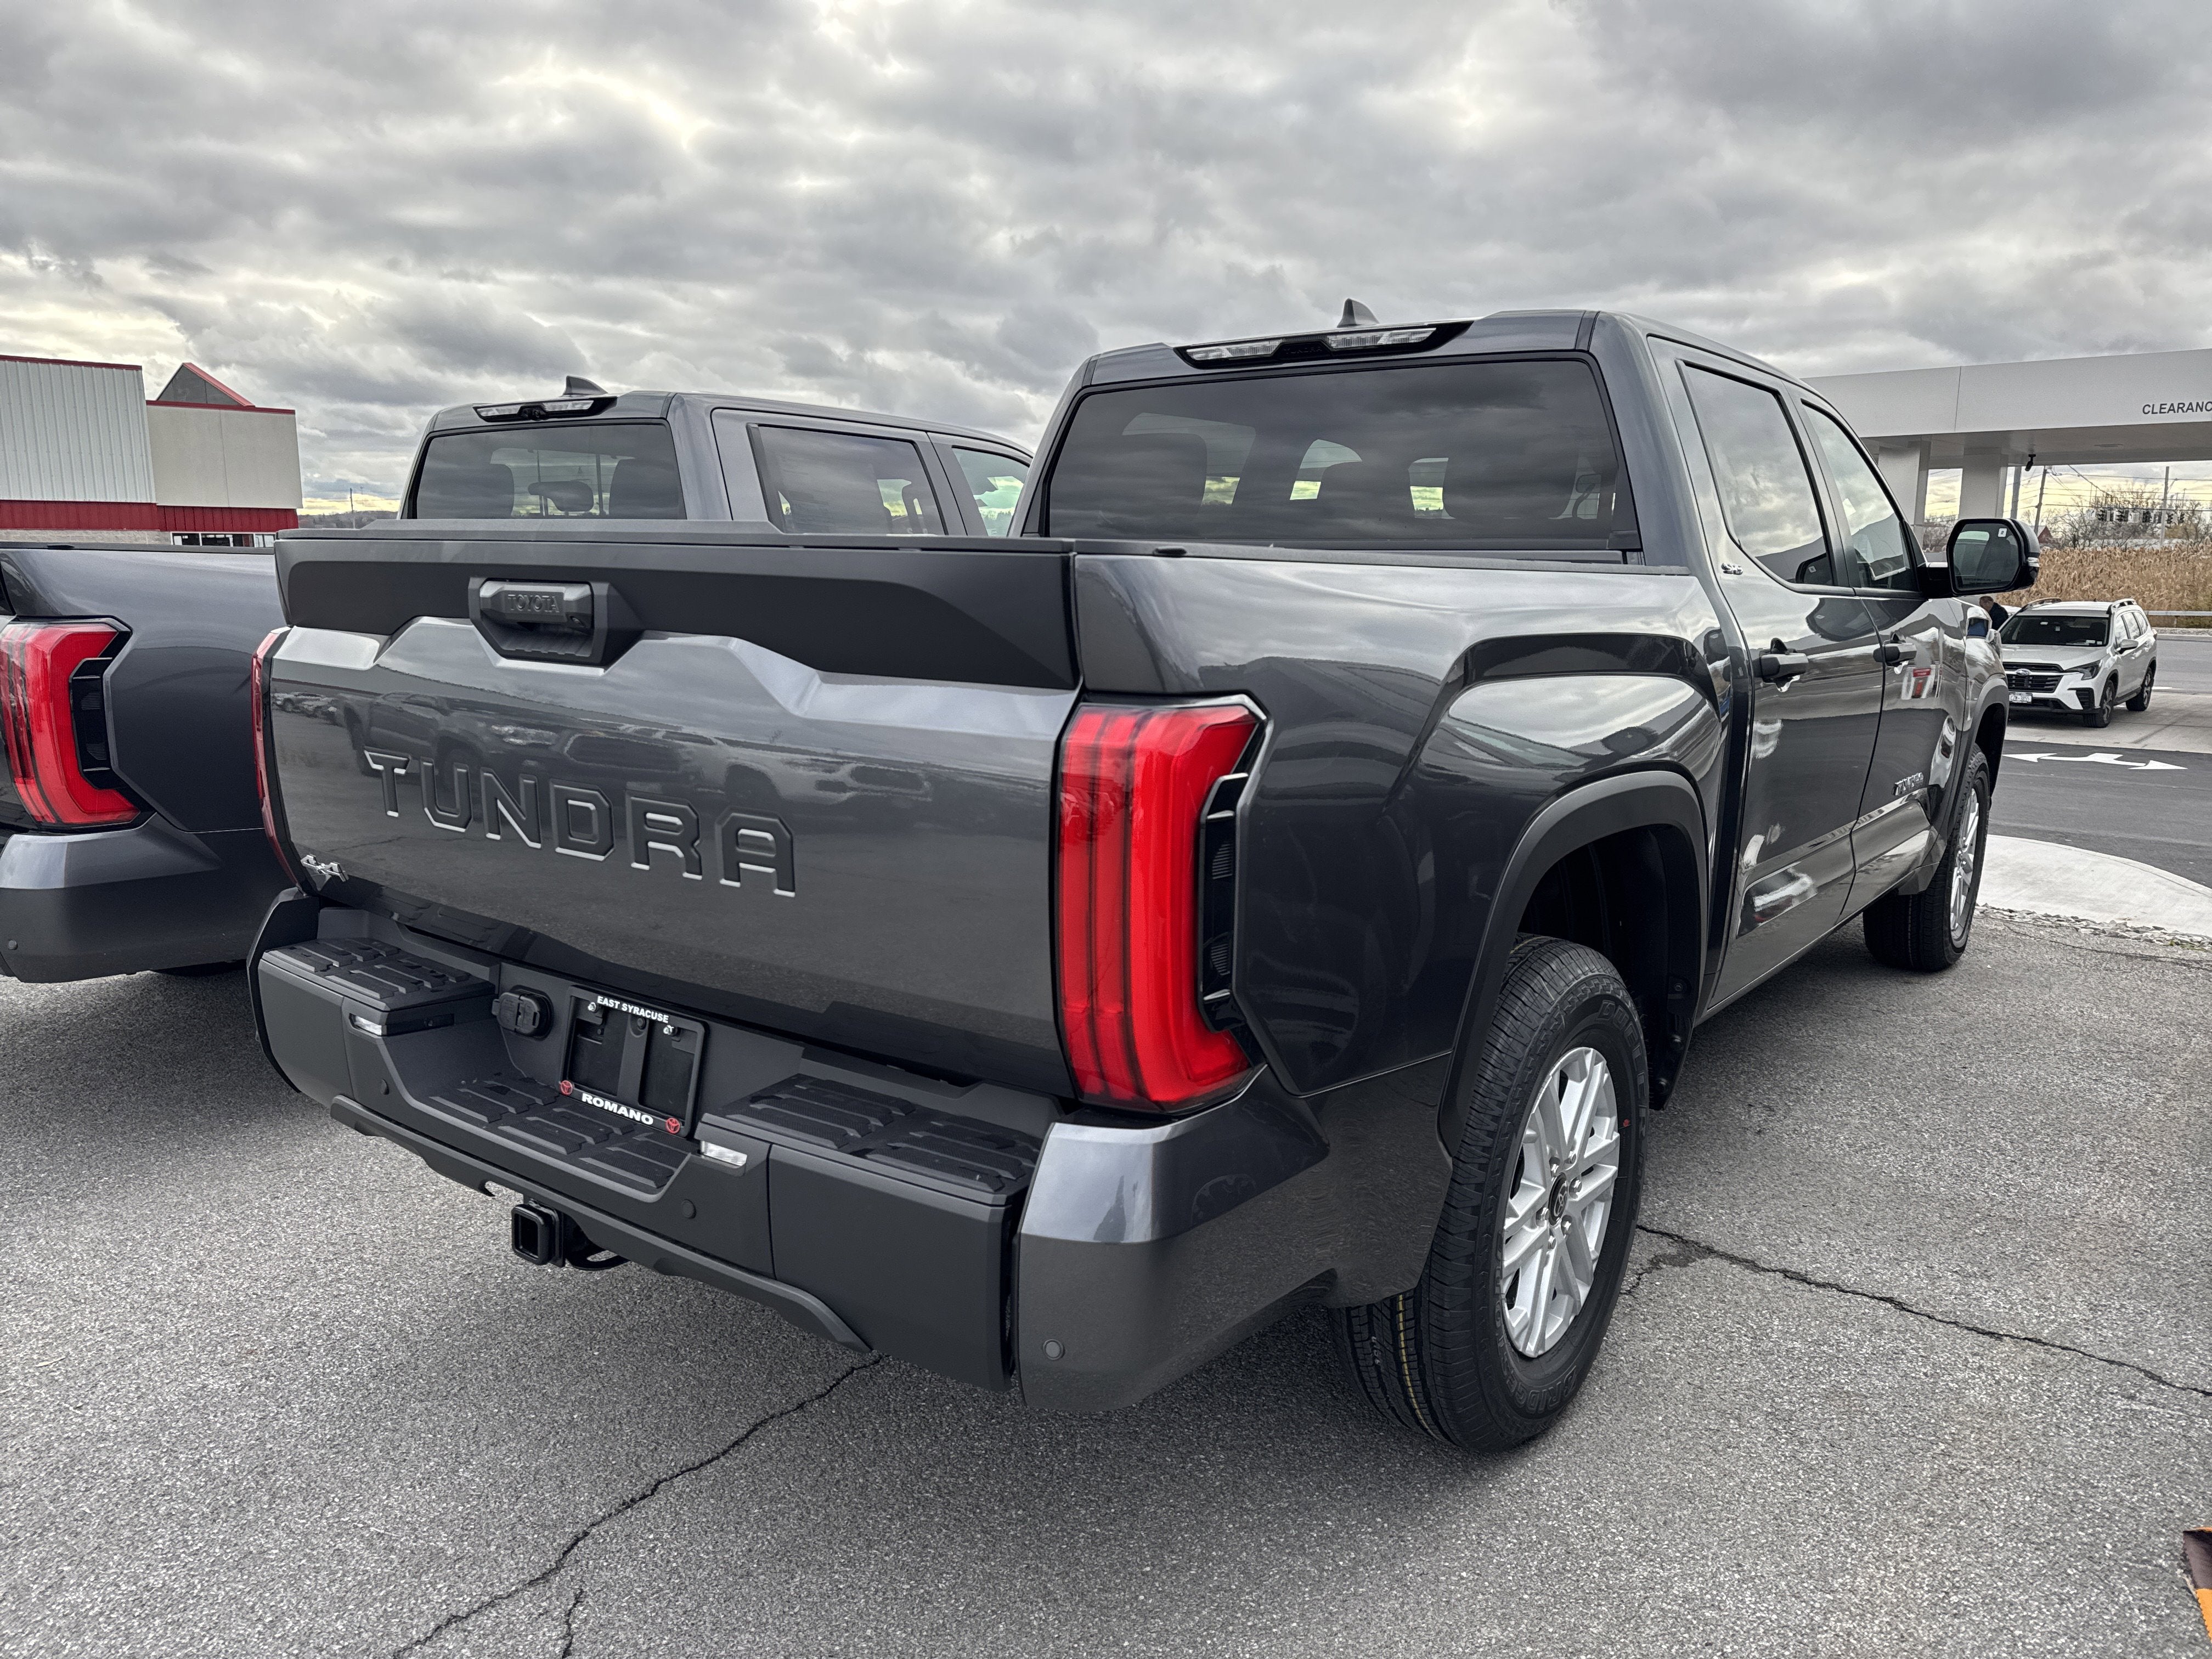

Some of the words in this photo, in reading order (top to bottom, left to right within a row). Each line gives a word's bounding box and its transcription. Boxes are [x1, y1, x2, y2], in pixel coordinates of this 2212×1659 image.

[507, 594, 560, 613] TOYOTA
[363, 747, 795, 898] TUNDRA
[597, 995, 620, 1009] EAST
[622, 1003, 669, 1024] SYRACUSE
[582, 1092, 654, 1126] ROMANO
